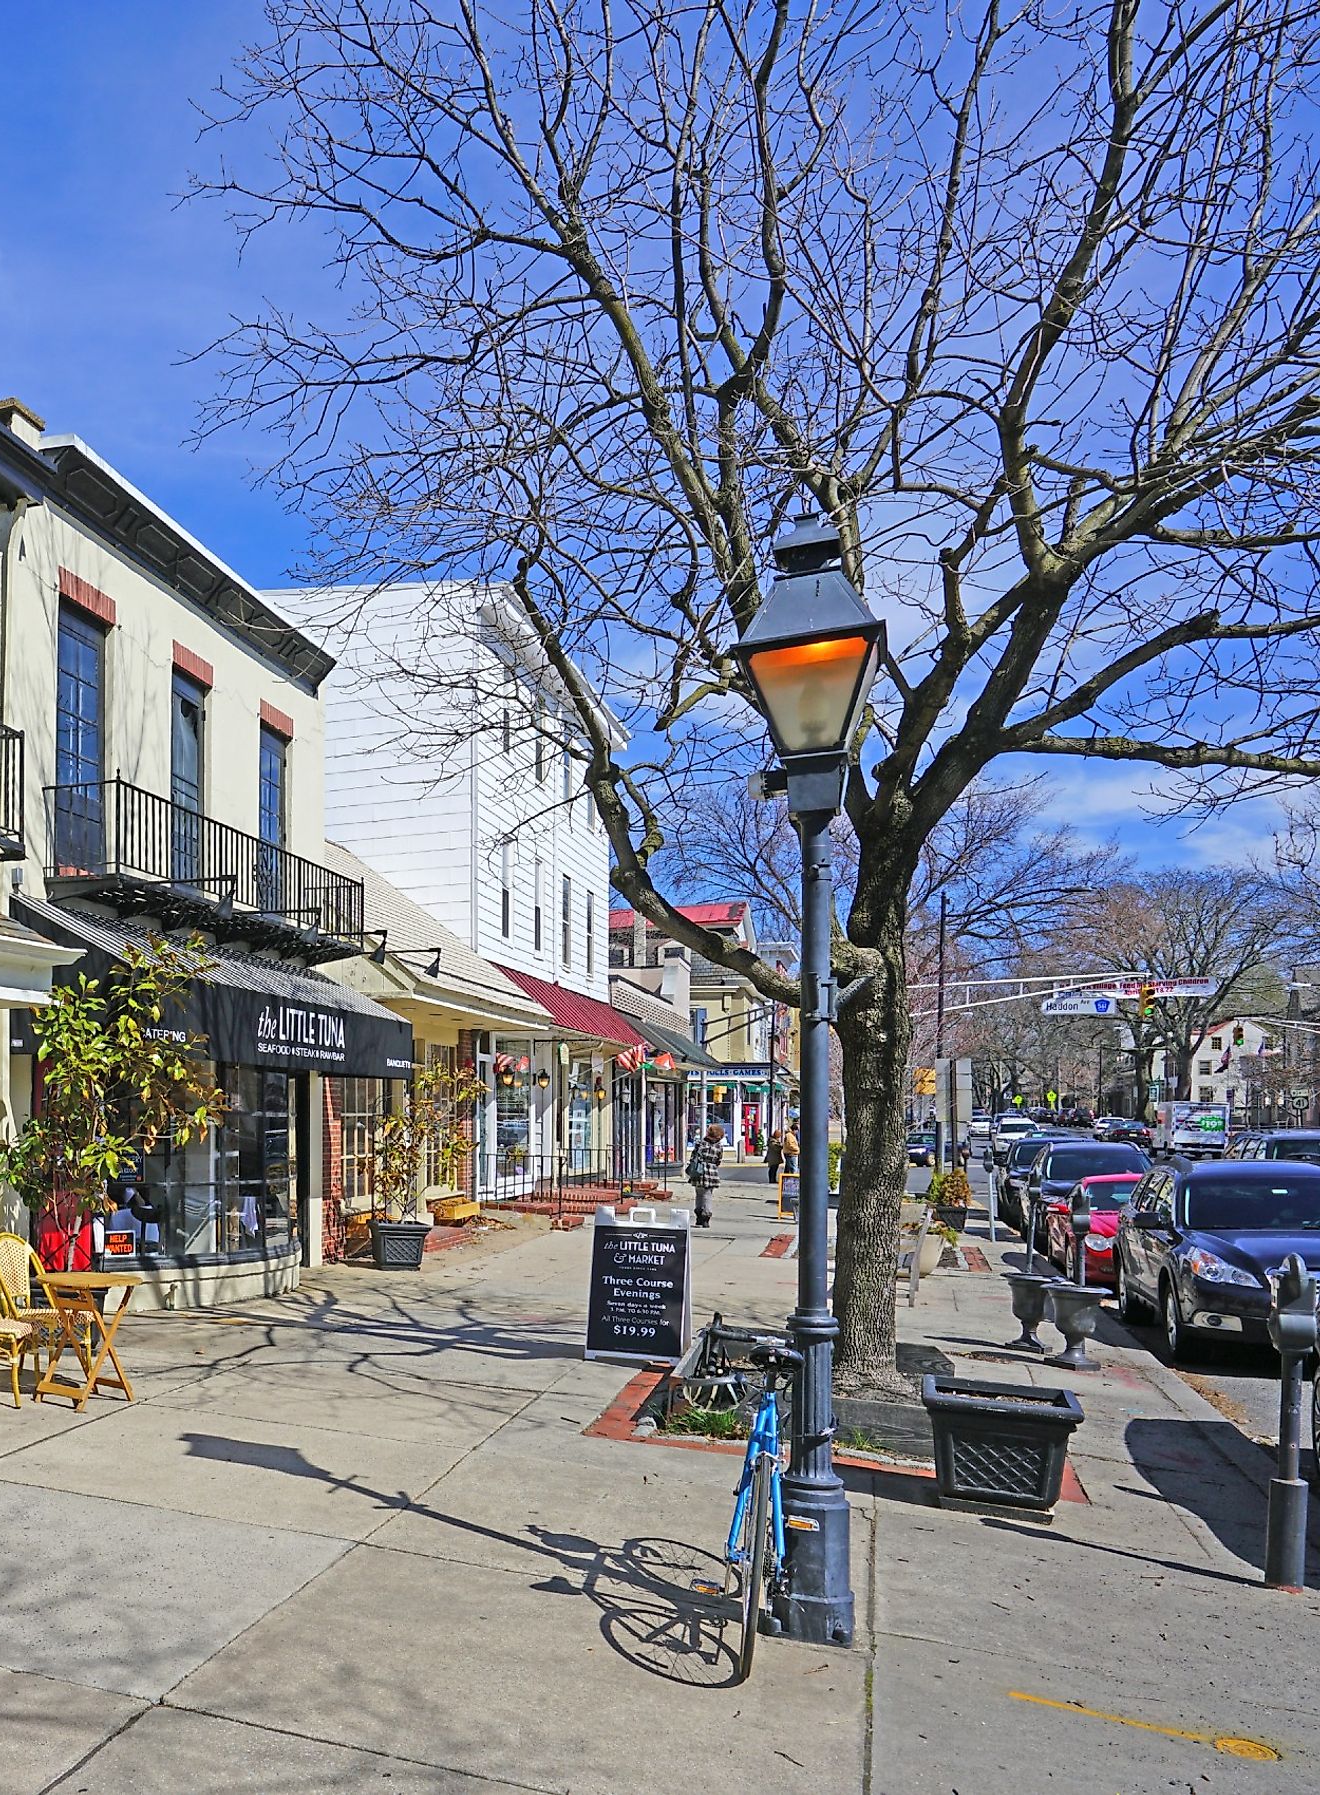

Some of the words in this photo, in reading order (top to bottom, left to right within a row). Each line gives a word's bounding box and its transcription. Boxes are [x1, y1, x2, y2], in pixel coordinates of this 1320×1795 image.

[1148, 980, 1177, 988] Starving
[1178, 978, 1209, 986] Children
[1046, 1002, 1079, 1011] Haddon
[257, 1006, 277, 1039] the
[279, 1006, 315, 1045] LITTLE
[318, 1013, 346, 1049] TUNA
[143, 1027, 186, 1042] ATERNG
[257, 1042, 291, 1055] SEAFOOD
[295, 1047, 316, 1058] STEAK
[1295, 1099, 1305, 1107] 41
[110, 1234, 127, 1242] HELP
[603, 1241, 619, 1250] the
[620, 1241, 649, 1251] LITTLE
[651, 1242, 676, 1253] TUNA
[614, 1252, 627, 1263] &
[628, 1254, 665, 1265] MARKET
[602, 1275, 634, 1286] Three
[636, 1277, 674, 1289] Course
[613, 1287, 661, 1300] Evenings
[612, 1315, 631, 1324] Three
[632, 1317, 658, 1326] Courses
[659, 1319, 670, 1327] for
[614, 1324, 657, 1338] $19.99
